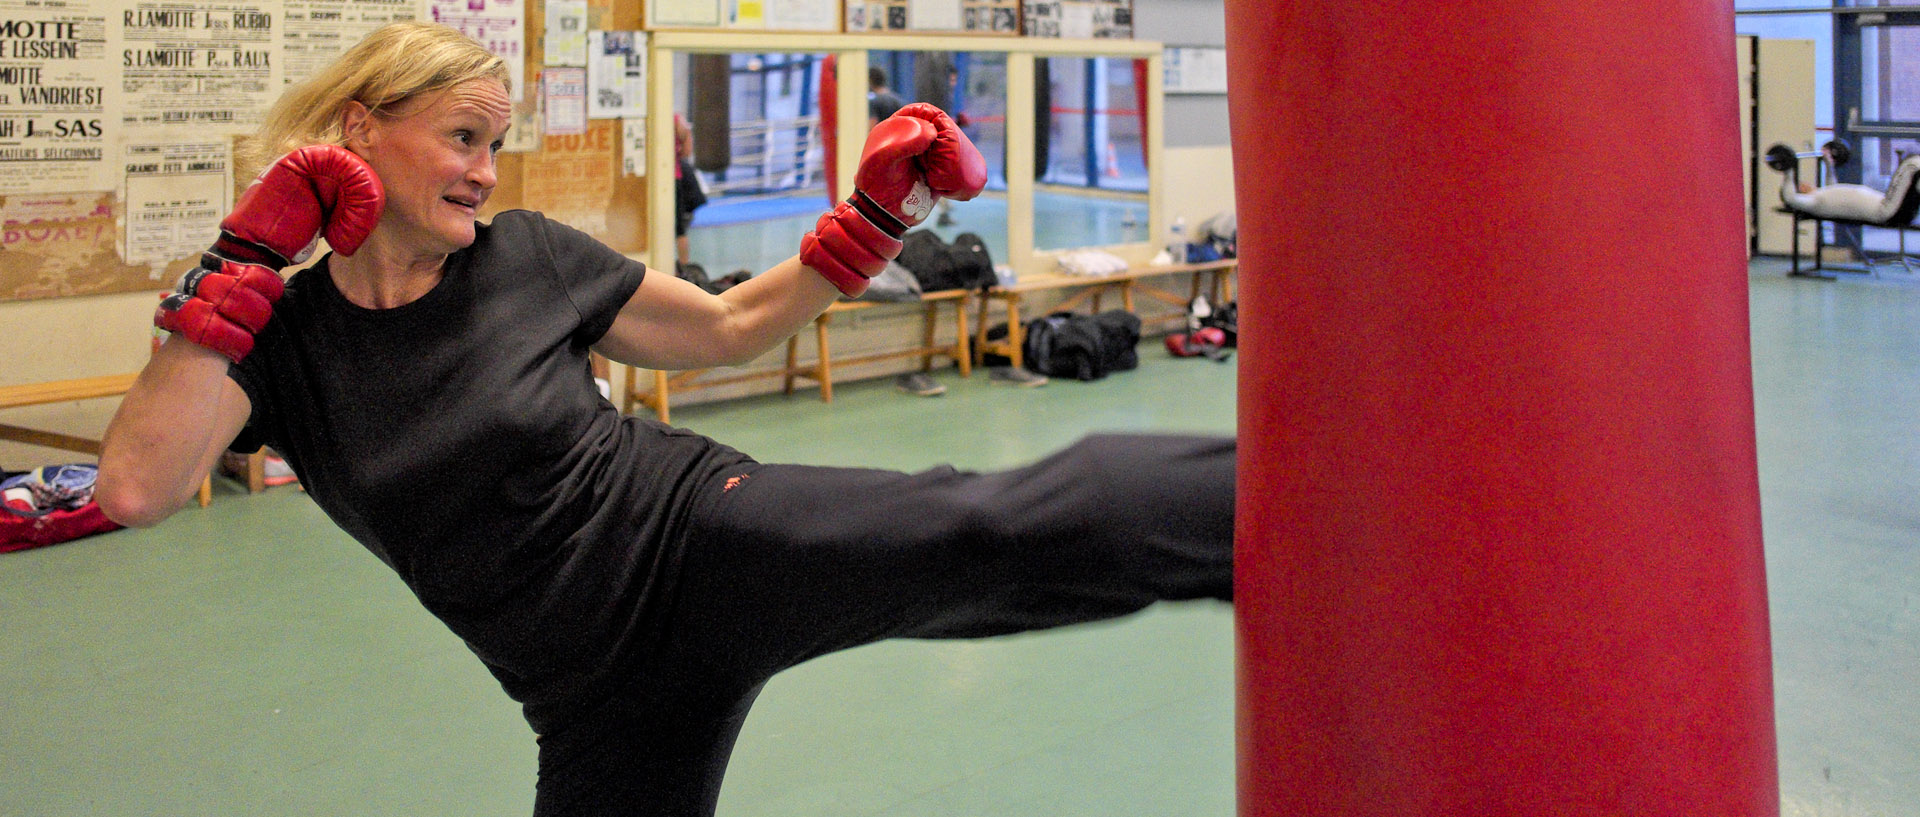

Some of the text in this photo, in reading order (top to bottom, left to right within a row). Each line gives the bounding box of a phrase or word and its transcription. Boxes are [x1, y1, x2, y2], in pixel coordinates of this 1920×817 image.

[233, 12, 272, 29] RUBIO
[13, 40, 79, 59] LESSEINE
[233, 50, 271, 67] RAUX
[20, 86, 104, 104] VANDRIEST
[55, 119, 103, 137] SAS
